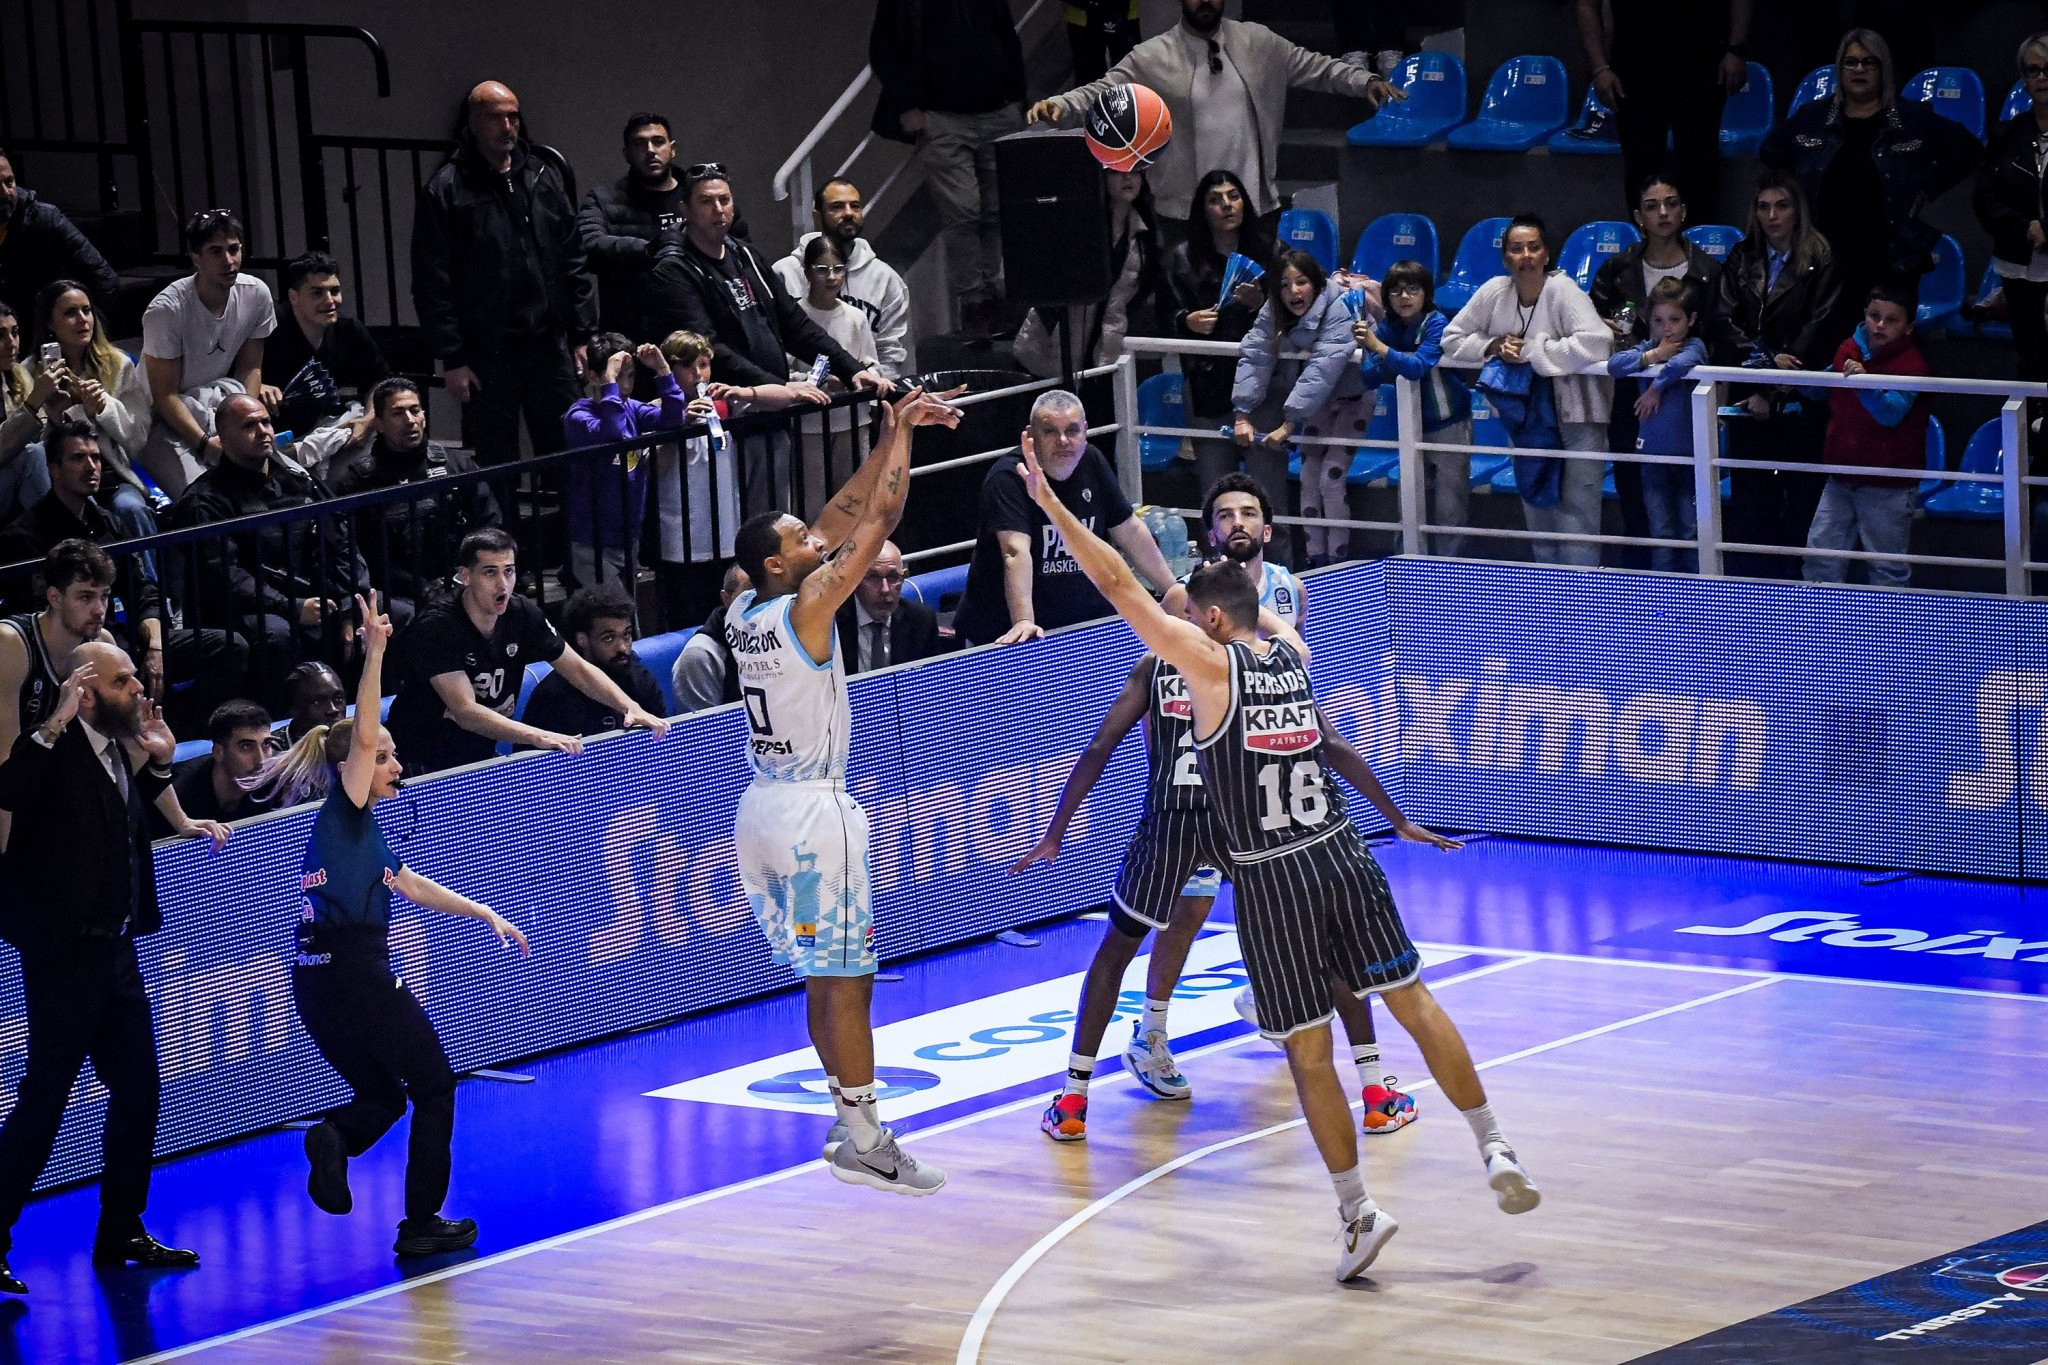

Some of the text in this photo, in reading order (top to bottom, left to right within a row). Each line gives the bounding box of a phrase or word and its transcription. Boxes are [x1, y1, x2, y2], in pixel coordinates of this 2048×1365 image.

[473, 668, 505, 699] 20
[744, 686, 773, 736] 0
[1269, 734, 1309, 746] PAINTS
[1874, 1292, 2026, 1342] THIRSTY
